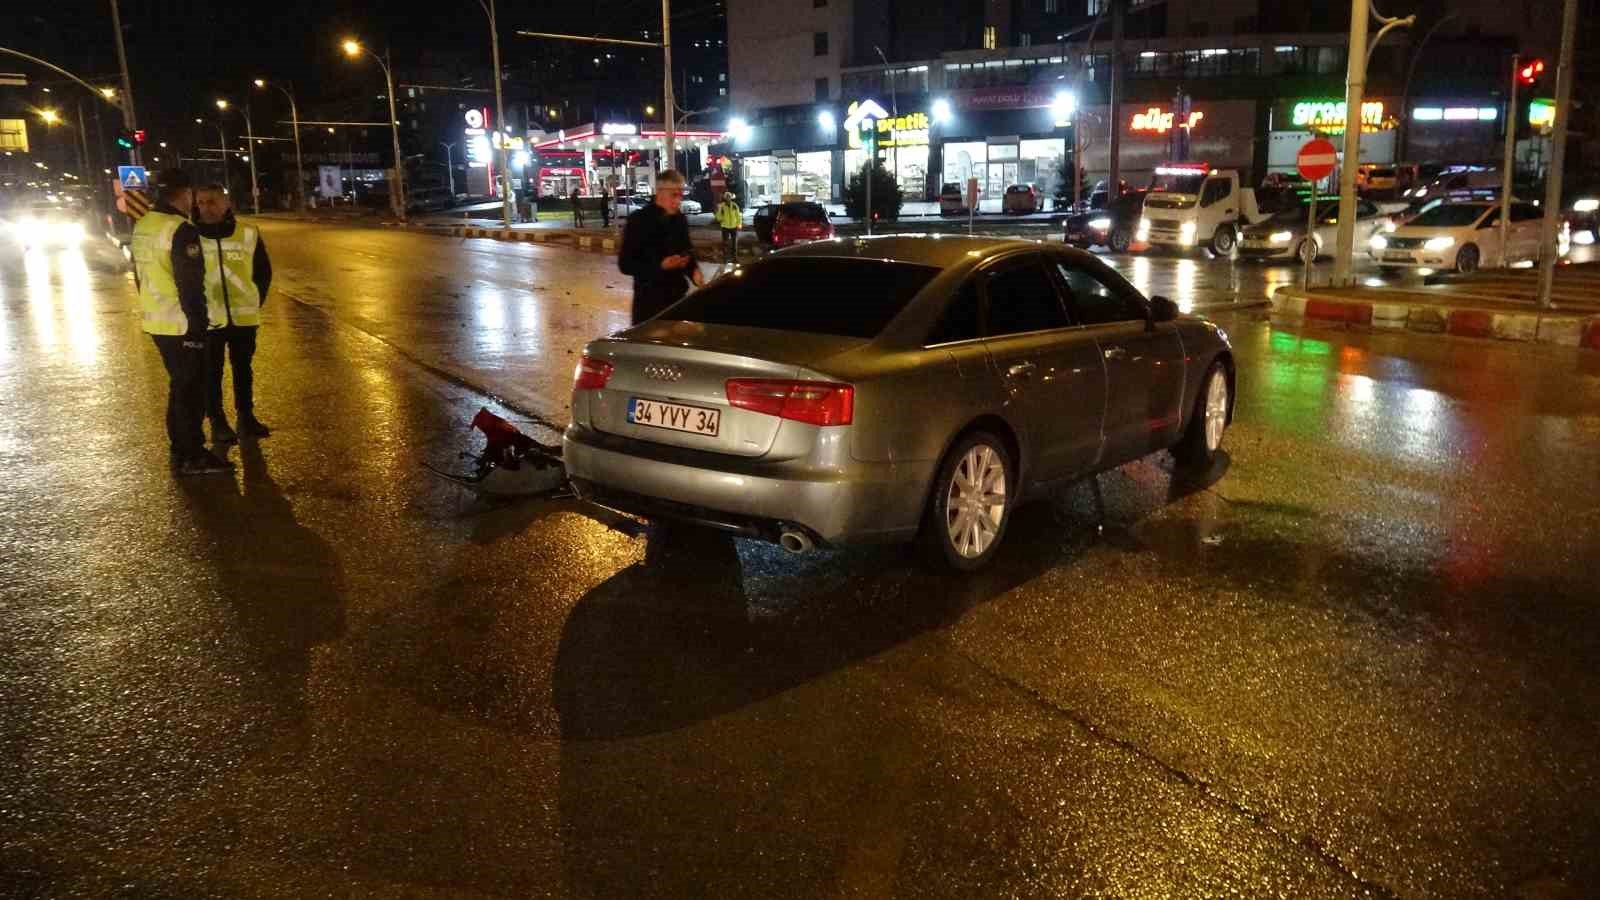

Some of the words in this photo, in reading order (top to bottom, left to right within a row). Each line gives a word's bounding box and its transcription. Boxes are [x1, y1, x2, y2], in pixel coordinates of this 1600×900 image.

[877, 113, 929, 132] pratik
[1131, 107, 1204, 134] süpr
[1293, 102, 1383, 125] grosm
[636, 401, 652, 422] 34
[659, 405, 691, 428] YVY
[696, 411, 716, 432] 34
